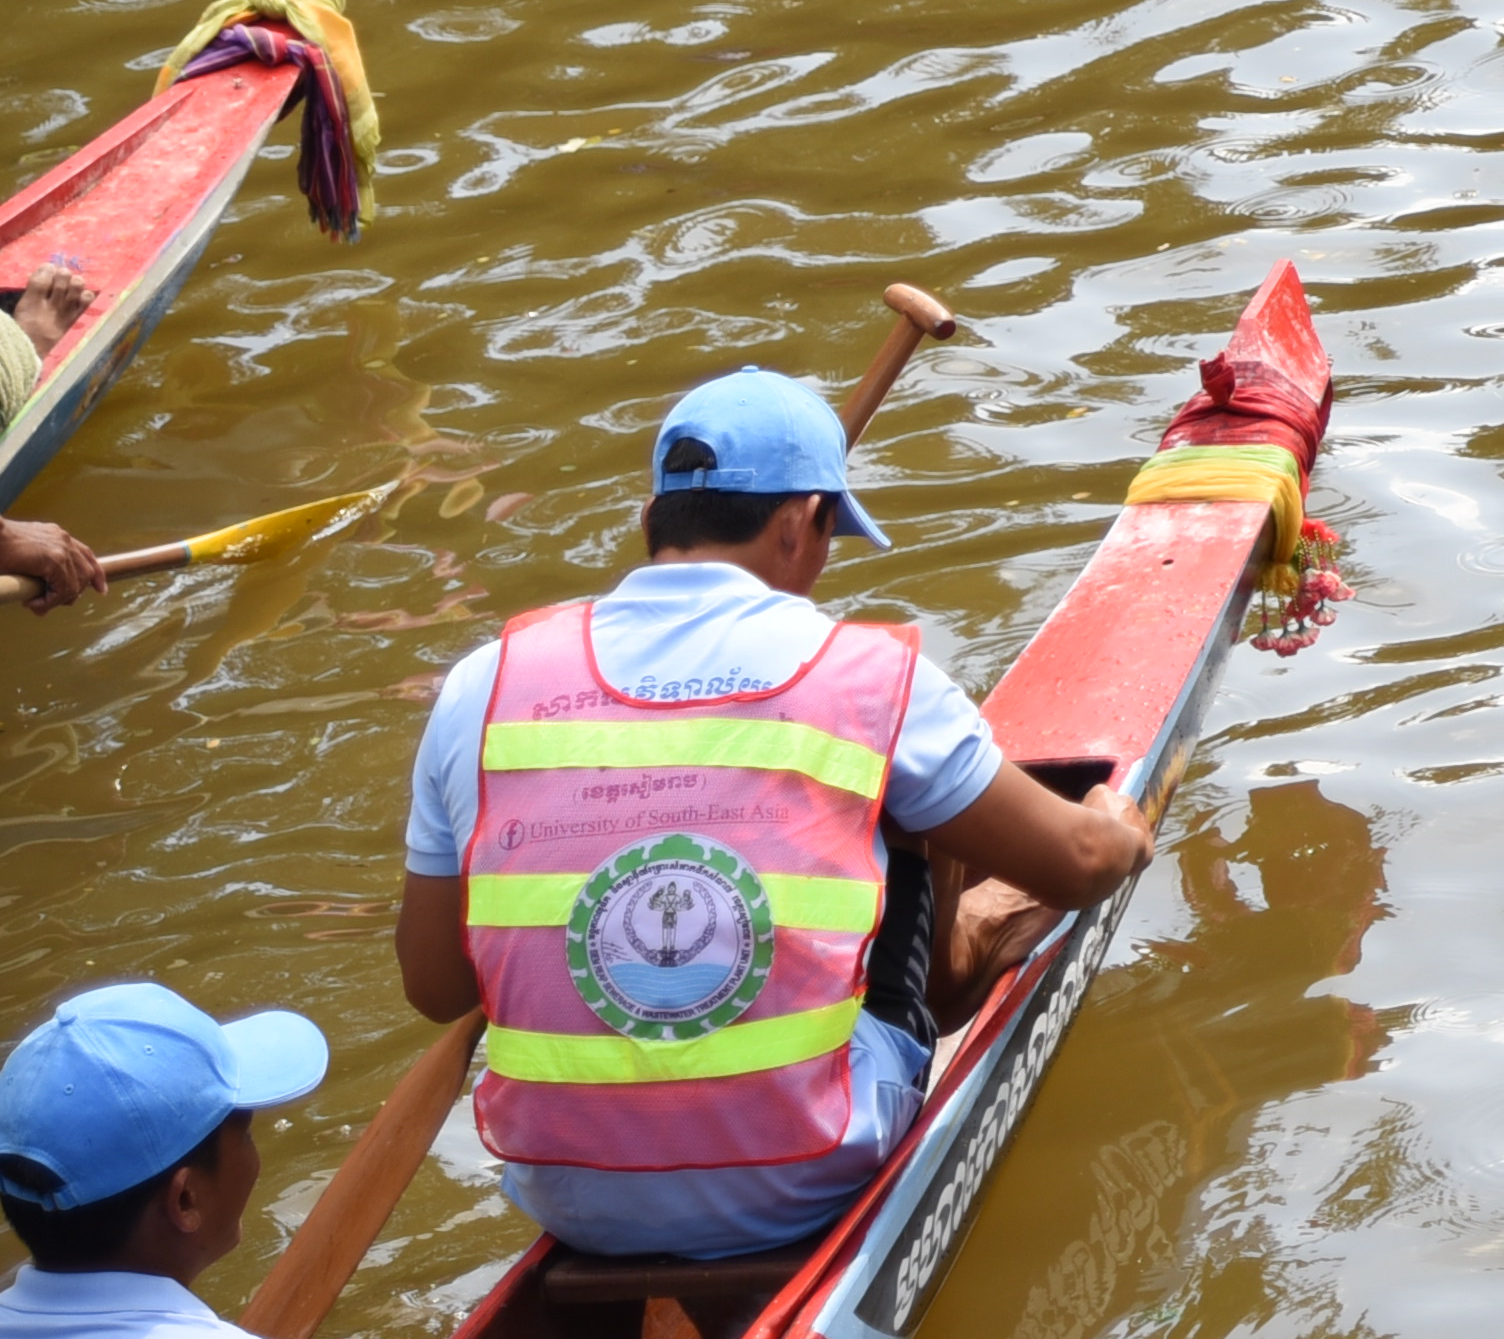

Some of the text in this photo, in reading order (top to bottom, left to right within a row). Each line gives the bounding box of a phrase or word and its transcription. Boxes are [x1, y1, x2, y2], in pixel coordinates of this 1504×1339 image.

[530, 815, 620, 840] University
[625, 810, 647, 829] of
[648, 804, 745, 824] South-East
[751, 804, 789, 820] Asia
